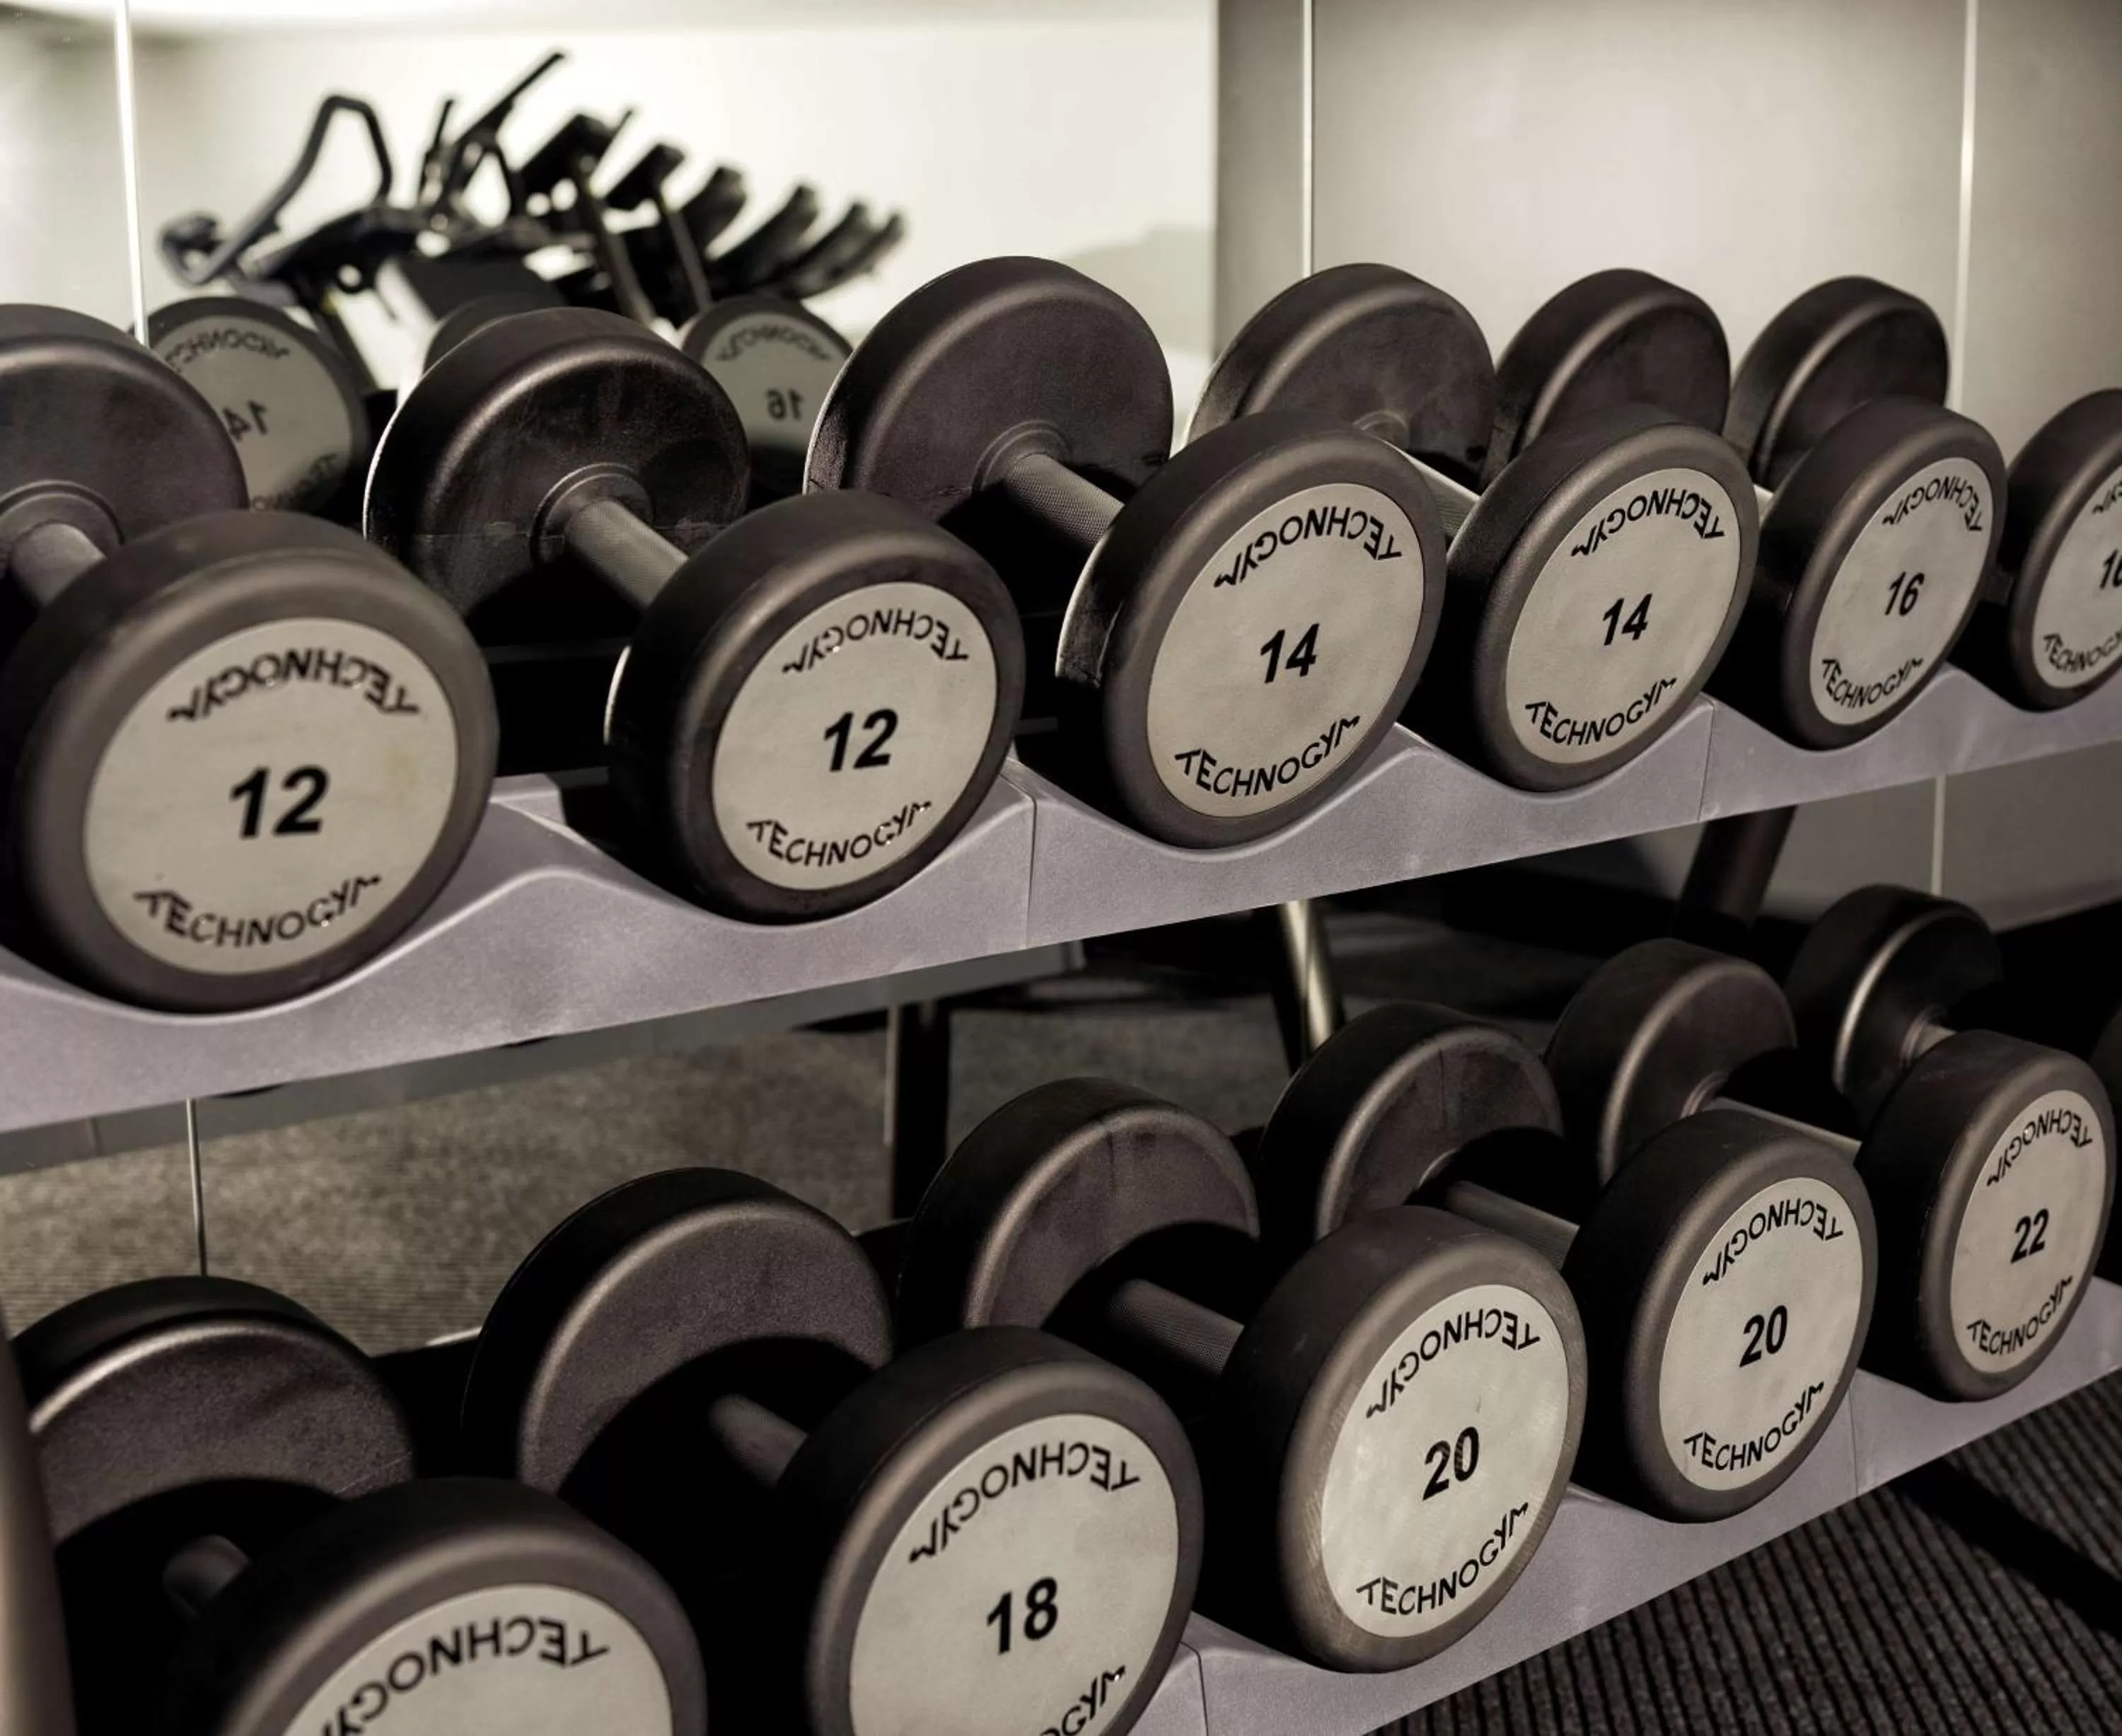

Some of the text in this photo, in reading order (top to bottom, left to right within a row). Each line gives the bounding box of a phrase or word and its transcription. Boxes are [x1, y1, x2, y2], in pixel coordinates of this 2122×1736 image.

[1570, 488, 1725, 556] TECHNOGYM
[1882, 476, 1983, 531] TECHNOGYM
[1214, 507, 1401, 587] TECHNOGYM
[1603, 594, 1652, 646] 14
[1884, 572, 1925, 615] 16
[782, 608, 970, 673] TECHNOGYM
[1260, 623, 1319, 683] 14
[166, 647, 422, 722] TECHNOGYM
[1525, 678, 1677, 746] TECHNOGYM
[1821, 656, 1923, 710] TECHNOGYM
[823, 709, 898, 772] 12
[1174, 716, 1359, 797] TECHNOGYM
[229, 765, 330, 838] 12
[746, 801, 932, 867] TECHNOGYM
[134, 874, 382, 947] TECHNOGYM
[1987, 1109, 2092, 1188] TECHNOGYM
[1703, 1198, 1843, 1285] TECHNOGYM
[2010, 1208, 2049, 1263] 22
[1739, 1305, 1787, 1368] 20
[1966, 1275, 2072, 1355] TECHNOGYM
[1366, 1309, 1541, 1418] TECHNOGYM
[1683, 1381, 1824, 1471] TECHNOGYM
[1422, 1426, 1480, 1501] 20
[908, 1441, 1140, 1563] TECHNOGYM
[1356, 1502, 1529, 1615] TECHNOGYM
[987, 1577, 1058, 1655] 18
[322, 1615, 610, 1736] TECHNOGY
